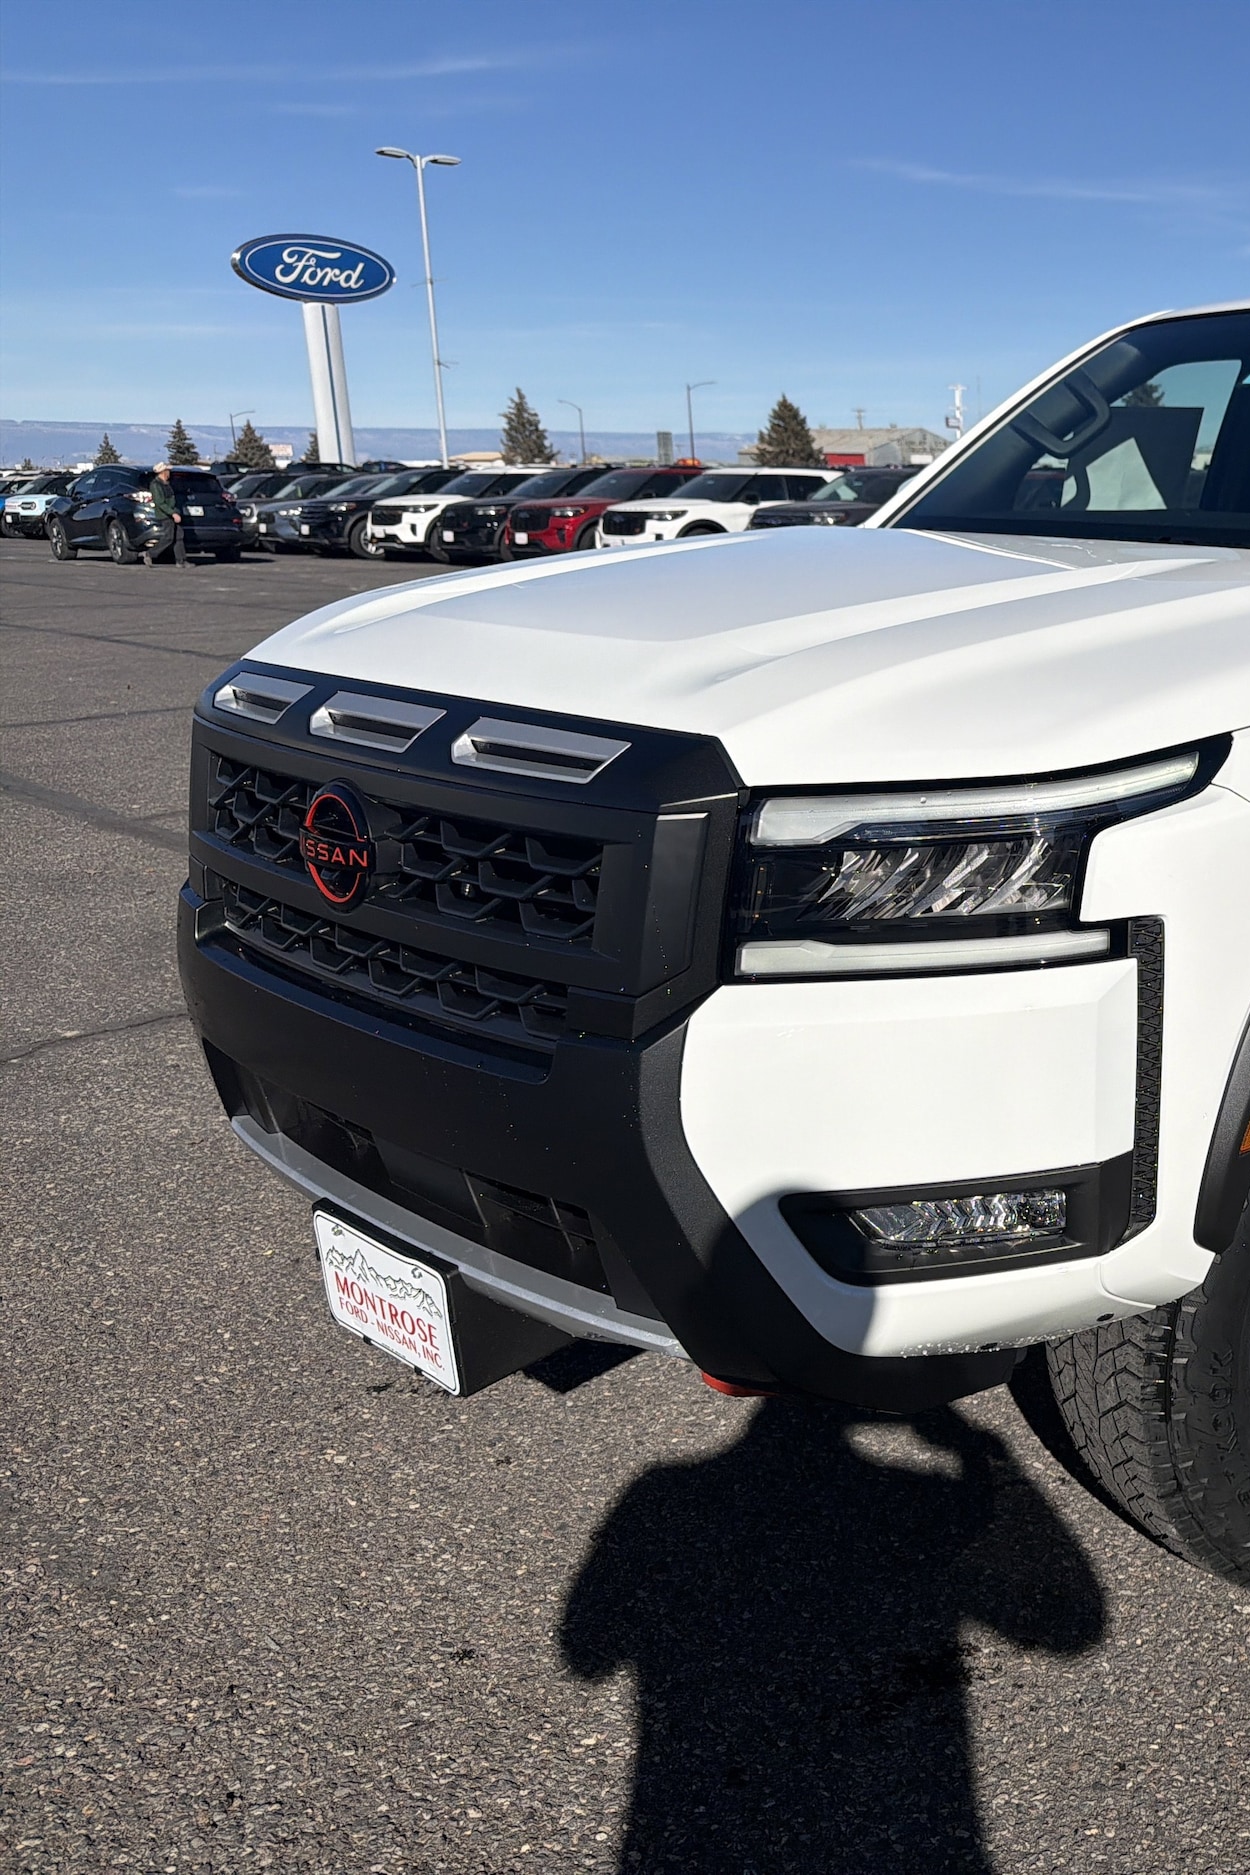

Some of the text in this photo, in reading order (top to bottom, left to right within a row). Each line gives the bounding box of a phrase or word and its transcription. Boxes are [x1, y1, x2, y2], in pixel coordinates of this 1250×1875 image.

[274, 246, 365, 289] Ford
[335, 1271, 440, 1351] MONTROSE
[339, 1296, 368, 1323] FORD
[376, 1319, 421, 1358] NISSAN,
[422, 1345, 445, 1371] INC.
